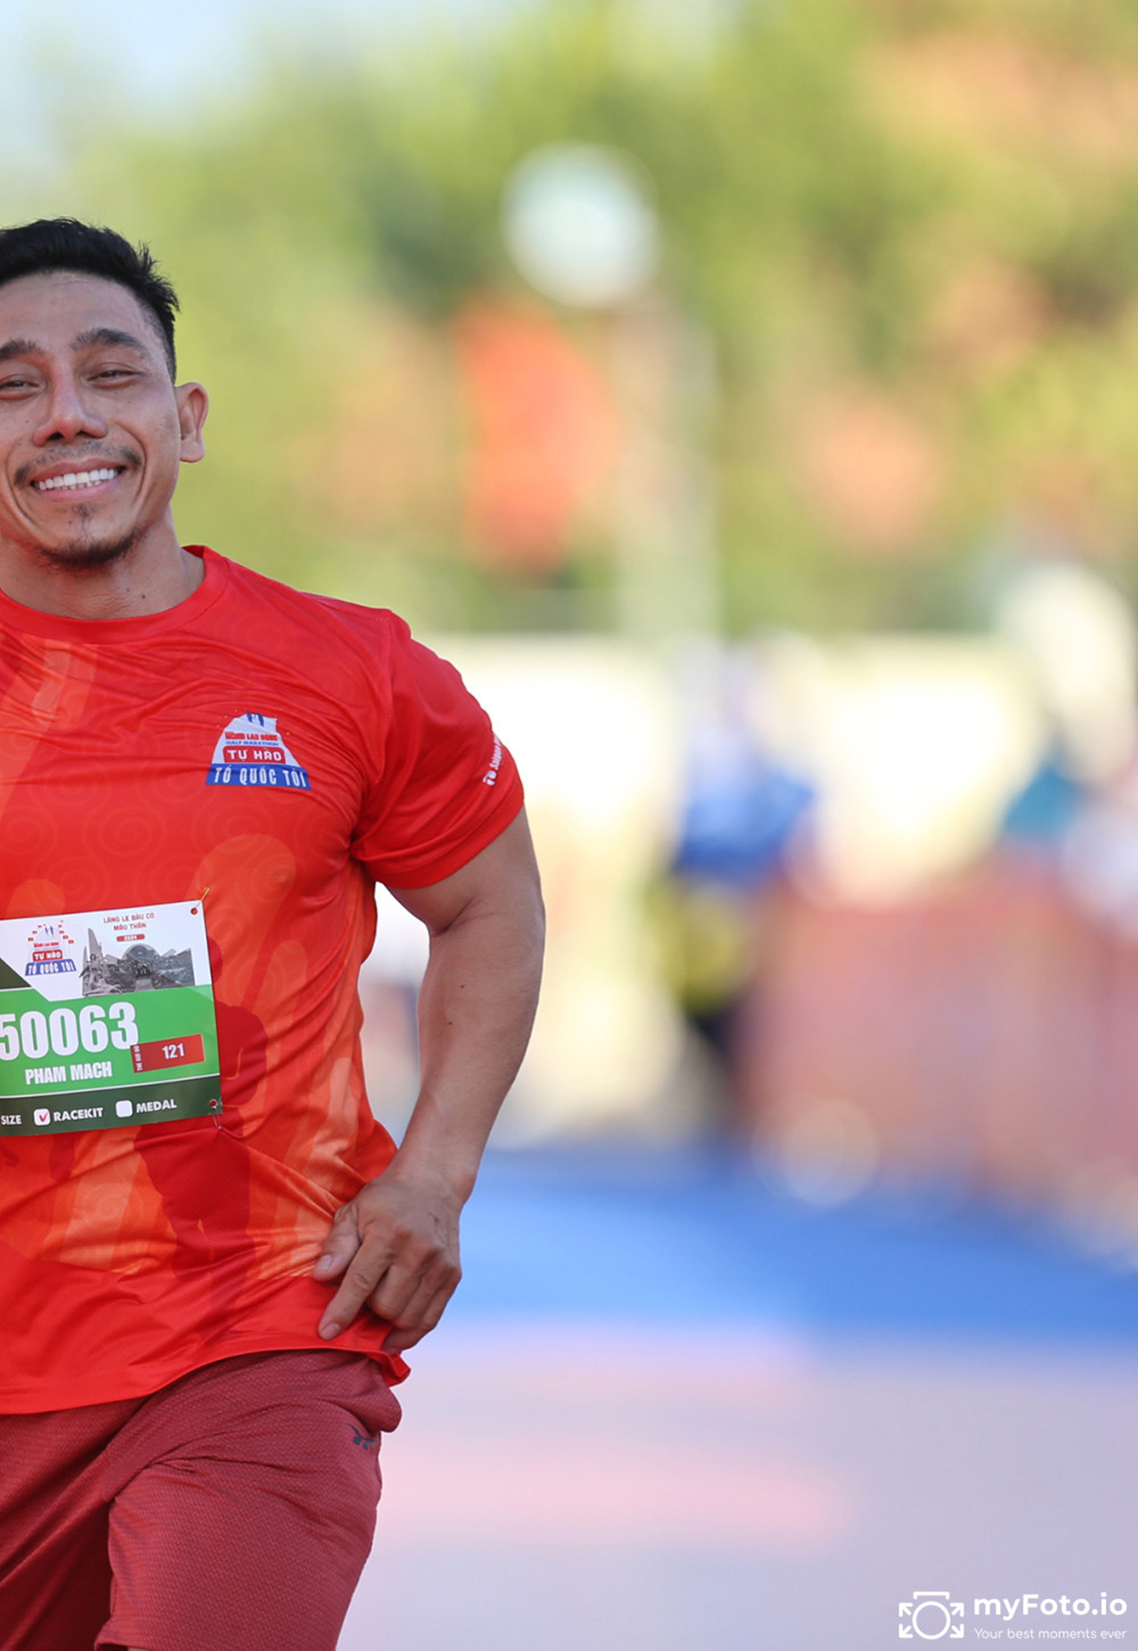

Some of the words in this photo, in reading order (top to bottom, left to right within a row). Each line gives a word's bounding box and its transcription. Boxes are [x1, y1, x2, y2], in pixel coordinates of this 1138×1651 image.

[227, 749, 248, 762] TỰ
[253, 748, 282, 761] HÀO
[161, 1043, 185, 1059] 121
[25, 1066, 67, 1085] PHAM
[70, 1061, 113, 1081] MACH
[136, 1099, 177, 1113] MEDAL
[1, 1114, 22, 1125] SIZE
[53, 1107, 104, 1122] RACEKIT
